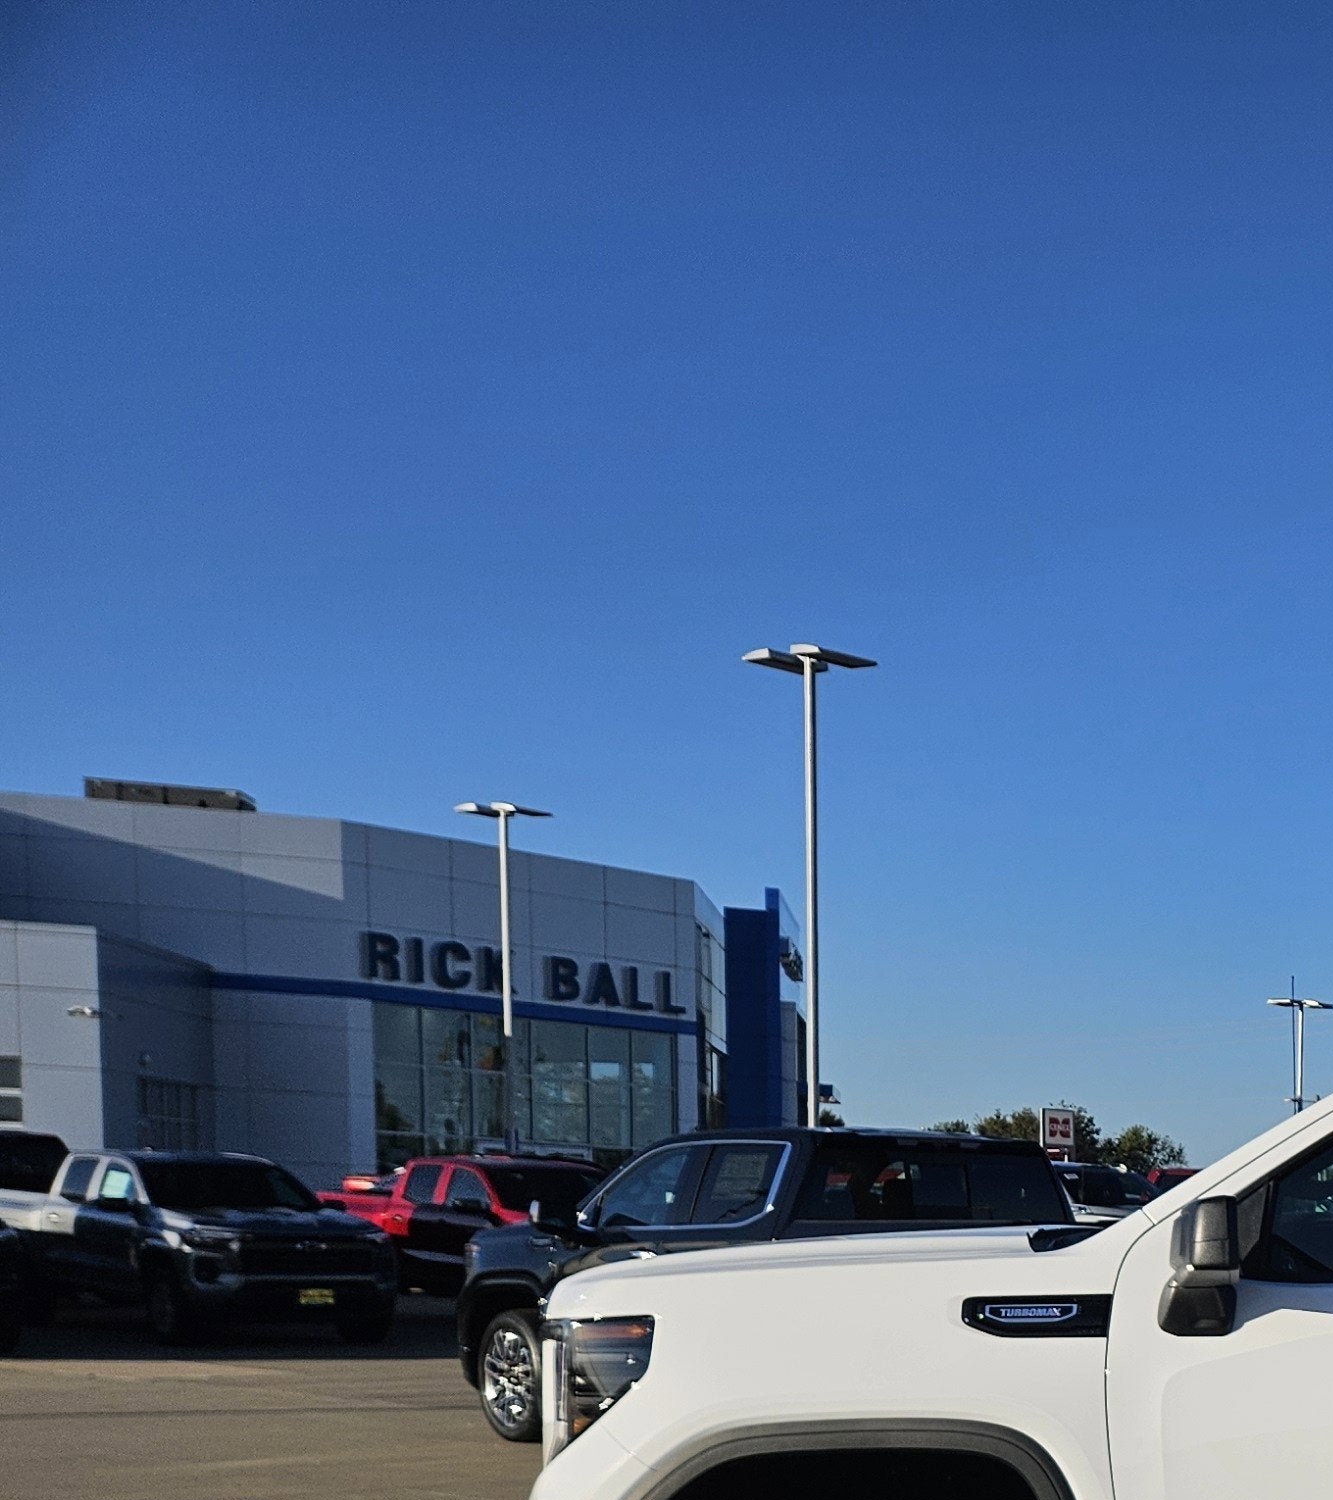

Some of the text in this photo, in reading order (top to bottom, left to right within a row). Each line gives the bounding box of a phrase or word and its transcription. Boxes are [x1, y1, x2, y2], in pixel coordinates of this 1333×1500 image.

[358, 931, 686, 1013] RICK BALL
[1000, 1307, 1062, 1317] TURBOMAX
